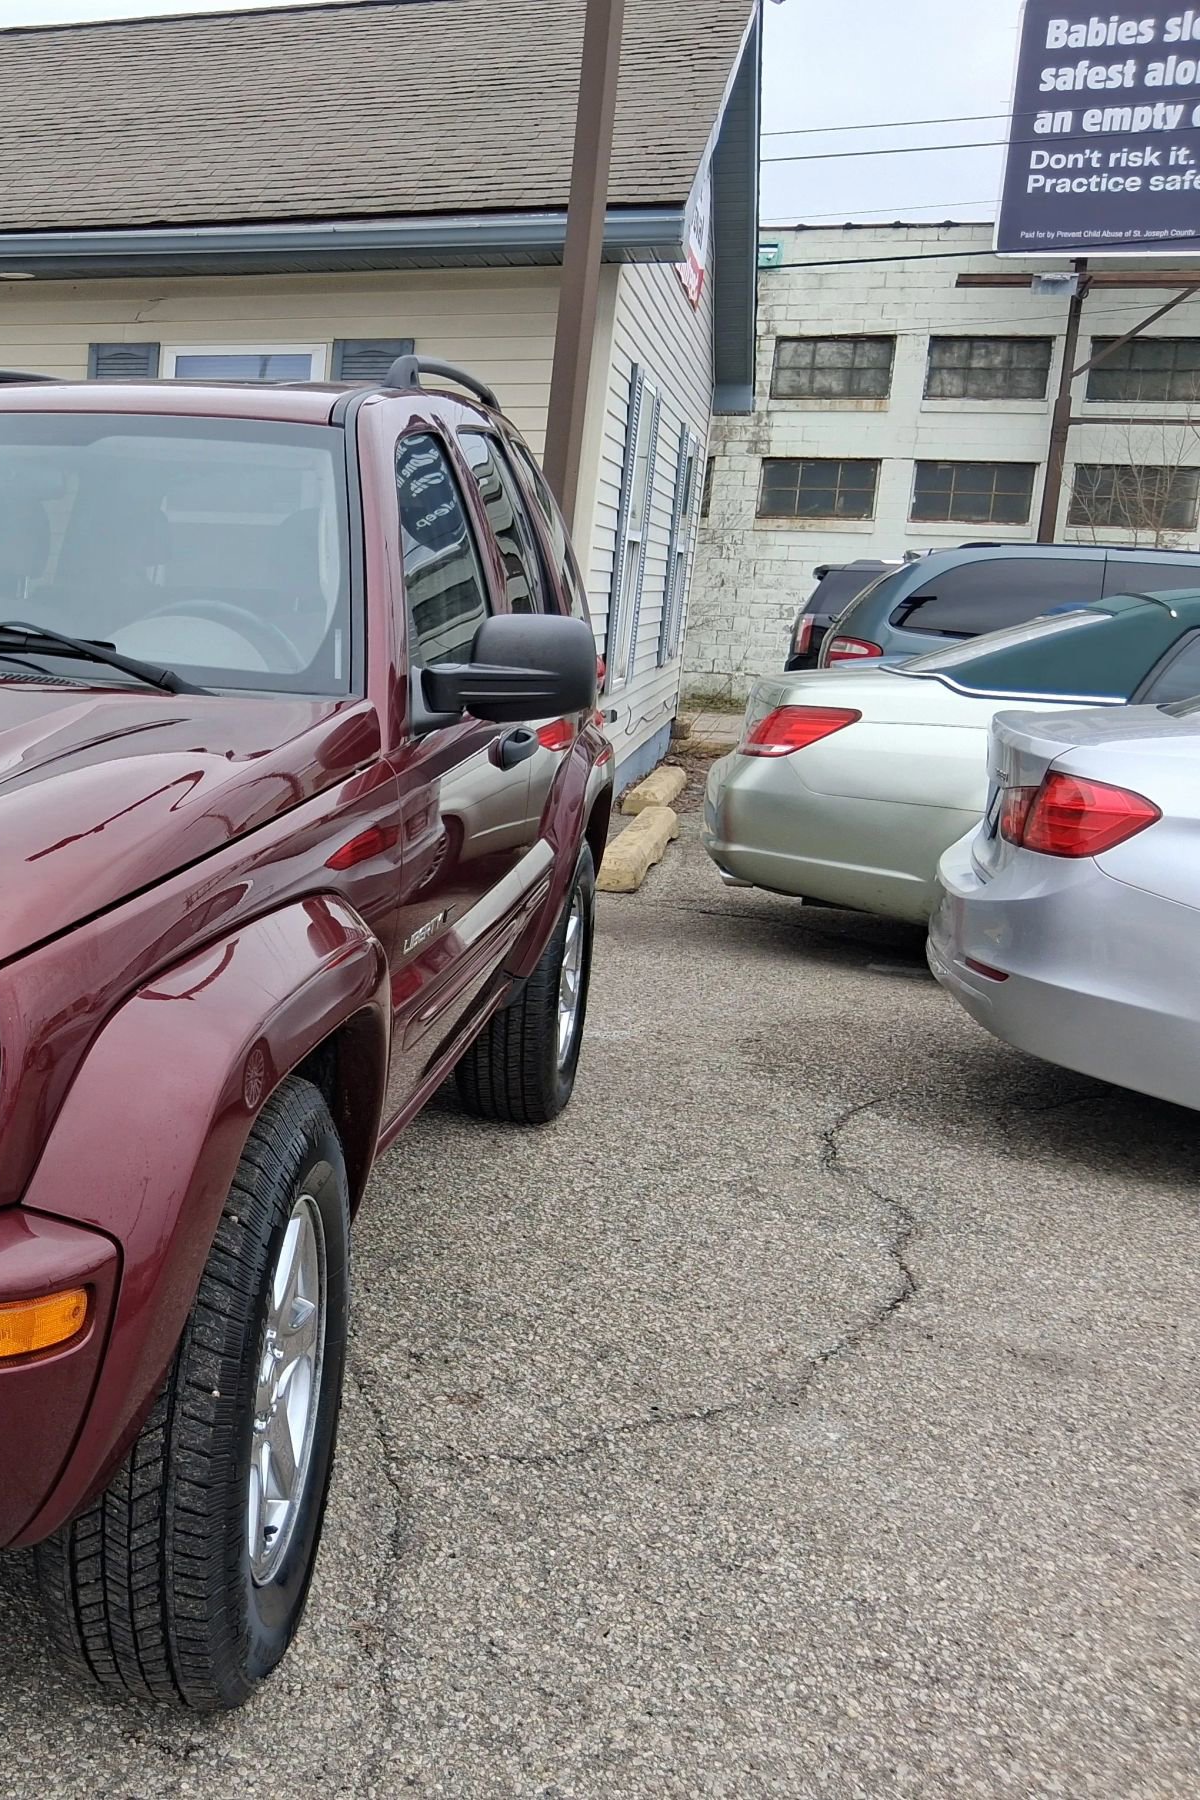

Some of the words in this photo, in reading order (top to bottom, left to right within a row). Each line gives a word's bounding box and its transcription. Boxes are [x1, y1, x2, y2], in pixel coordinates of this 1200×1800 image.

[1046, 15, 1155, 49] Babies
[1039, 60, 1136, 91] safest
[1144, 55, 1200, 87] alo
[1033, 110, 1073, 134] an
[1082, 102, 1184, 132] empty
[1029, 150, 1101, 169] Don't
[1108, 146, 1162, 167] risk
[1169, 146, 1195, 166] it.
[1027, 174, 1142, 193] Practice
[1020, 231, 1035, 239] Paid
[1036, 231, 1045, 239] for
[1046, 231, 1055, 240] by
[1056, 230, 1082, 238] Prevent
[1083, 230, 1100, 238] Child
[1101, 230, 1123, 238] Abuse
[1124, 229, 1132, 238] of
[1143, 228, 1169, 238] Joseph
[1170, 228, 1196, 237] County
